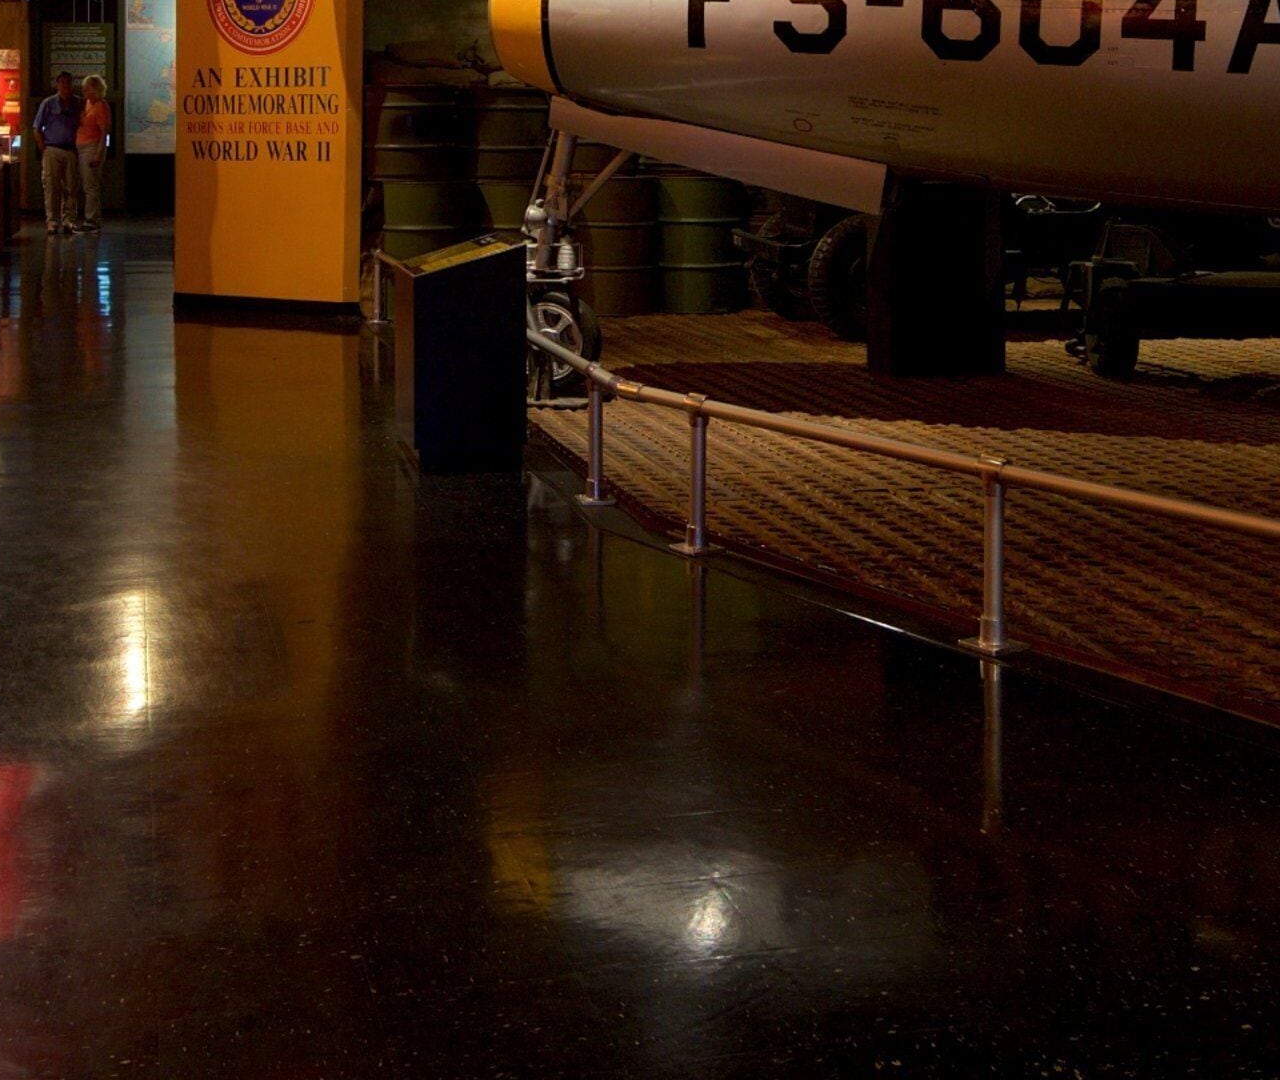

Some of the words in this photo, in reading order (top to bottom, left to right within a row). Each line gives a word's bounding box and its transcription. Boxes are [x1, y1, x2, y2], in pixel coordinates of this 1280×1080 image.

[192, 67, 222, 88] AN
[235, 66, 332, 88] EXHIBIT
[183, 94, 340, 116] COMMEMORATING
[187, 121, 224, 134] ROBINS
[228, 121, 245, 134] AIR
[248, 121, 281, 134] FORCE
[286, 121, 312, 134] BASE
[316, 121, 340, 135] AND
[192, 140, 258, 162] WORLD
[266, 140, 308, 162] WAR
[317, 140, 331, 162] II
